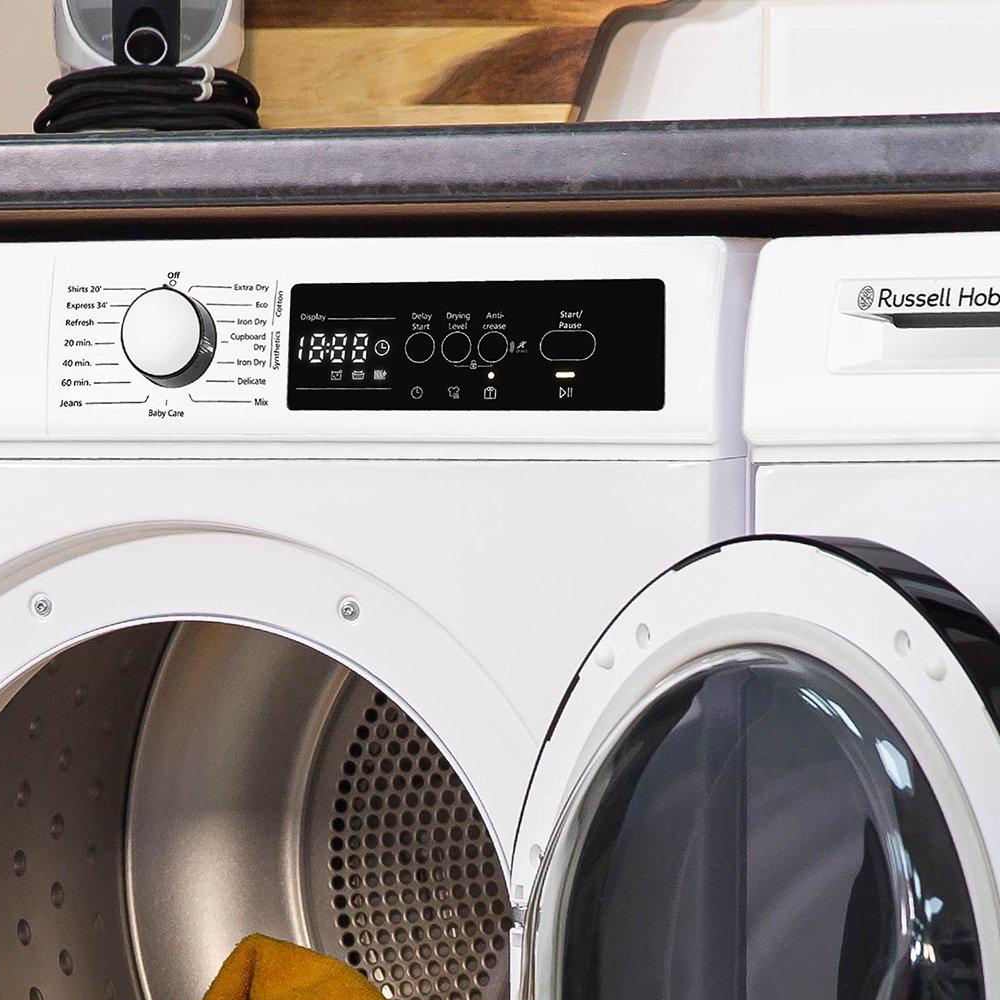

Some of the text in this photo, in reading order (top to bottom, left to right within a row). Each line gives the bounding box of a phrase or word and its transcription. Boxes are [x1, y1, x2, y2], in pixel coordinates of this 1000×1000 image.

[167, 271, 181, 280] Off
[67, 285, 89, 293] Shirts
[233, 283, 270, 293] Extra Dry
[877, 287, 952, 308] Russell
[66, 301, 95, 311] Express
[255, 301, 269, 309] Eco
[275, 290, 284, 318] Cotton
[300, 313, 327, 322] Display
[411, 312, 433, 322] Delay
[446, 311, 471, 322] Drying
[485, 311, 505, 320] Anti-
[559, 309, 584, 320] Start/
[65, 318, 95, 327] Refresh
[236, 317, 268, 327] Iron Dry
[411, 322, 431, 331] Start
[448, 321, 468, 331] Level
[482, 322, 507, 331] crease
[558, 320, 583, 330] Pause
[229, 332, 267, 342] Cupboard
[63, 338, 93, 347] 20 min.
[253, 342, 267, 352] Dry
[272, 330, 282, 371] Synthetics
[62, 358, 93, 368] 40 min.
[236, 358, 267, 368] Iron Dry
[60, 378, 92, 387] 60 min.
[237, 376, 267, 386] Delicate
[59, 399, 83, 408] Jeans
[254, 398, 269, 407] Mix
[148, 408, 185, 419] Baby Care
